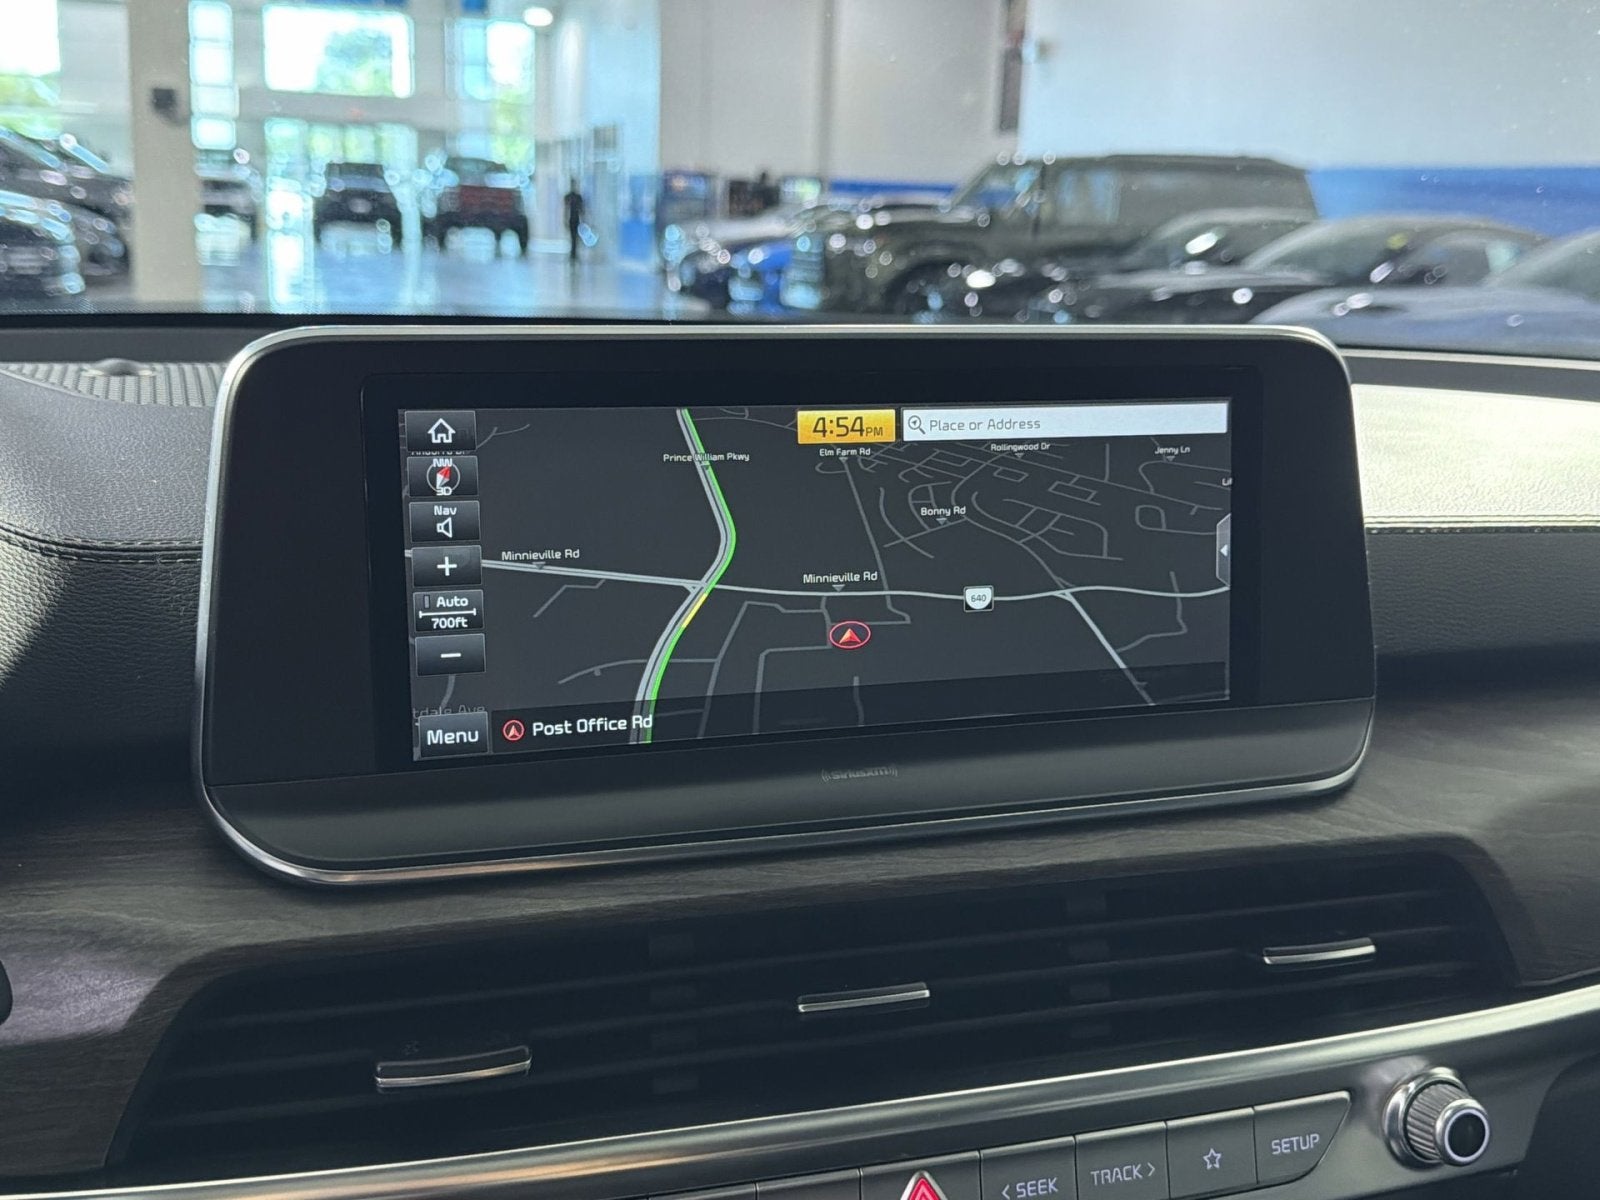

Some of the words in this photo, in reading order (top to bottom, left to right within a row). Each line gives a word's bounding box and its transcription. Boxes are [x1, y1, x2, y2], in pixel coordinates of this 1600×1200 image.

[812, 416, 865, 438] 4:54
[865, 426, 884, 437] PM
[929, 419, 966, 432] Place
[968, 421, 984, 431] or
[987, 418, 1041, 431] Address
[819, 448, 834, 457] Elm
[836, 448, 858, 457] Farm
[859, 448, 871, 456] Rd
[990, 443, 1038, 454] Rollingwood
[1039, 442, 1051, 452] Dr
[1154, 446, 1177, 456] Jenny
[1179, 445, 1191, 454] Ln
[663, 453, 692, 462] Prince
[693, 453, 724, 462] William
[726, 452, 750, 462] Pkwy
[433, 505, 457, 516] Nav
[920, 506, 951, 518] Bonny
[953, 506, 967, 516] Rd
[501, 550, 562, 561] Minnieville
[564, 549, 580, 560] Rd
[803, 573, 861, 585] Minnieville
[863, 571, 879, 583] Rd
[436, 596, 469, 608] Auto
[970, 594, 987, 603] 640
[431, 616, 468, 630] 700ft
[532, 721, 572, 737] Post
[577, 716, 627, 733] Office
[632, 715, 653, 730] Rd
[426, 729, 479, 745] Menu
[1271, 1133, 1320, 1156] SETUP
[1090, 1163, 1143, 1186] TRACK
[1015, 1177, 1059, 1198] SEEK
